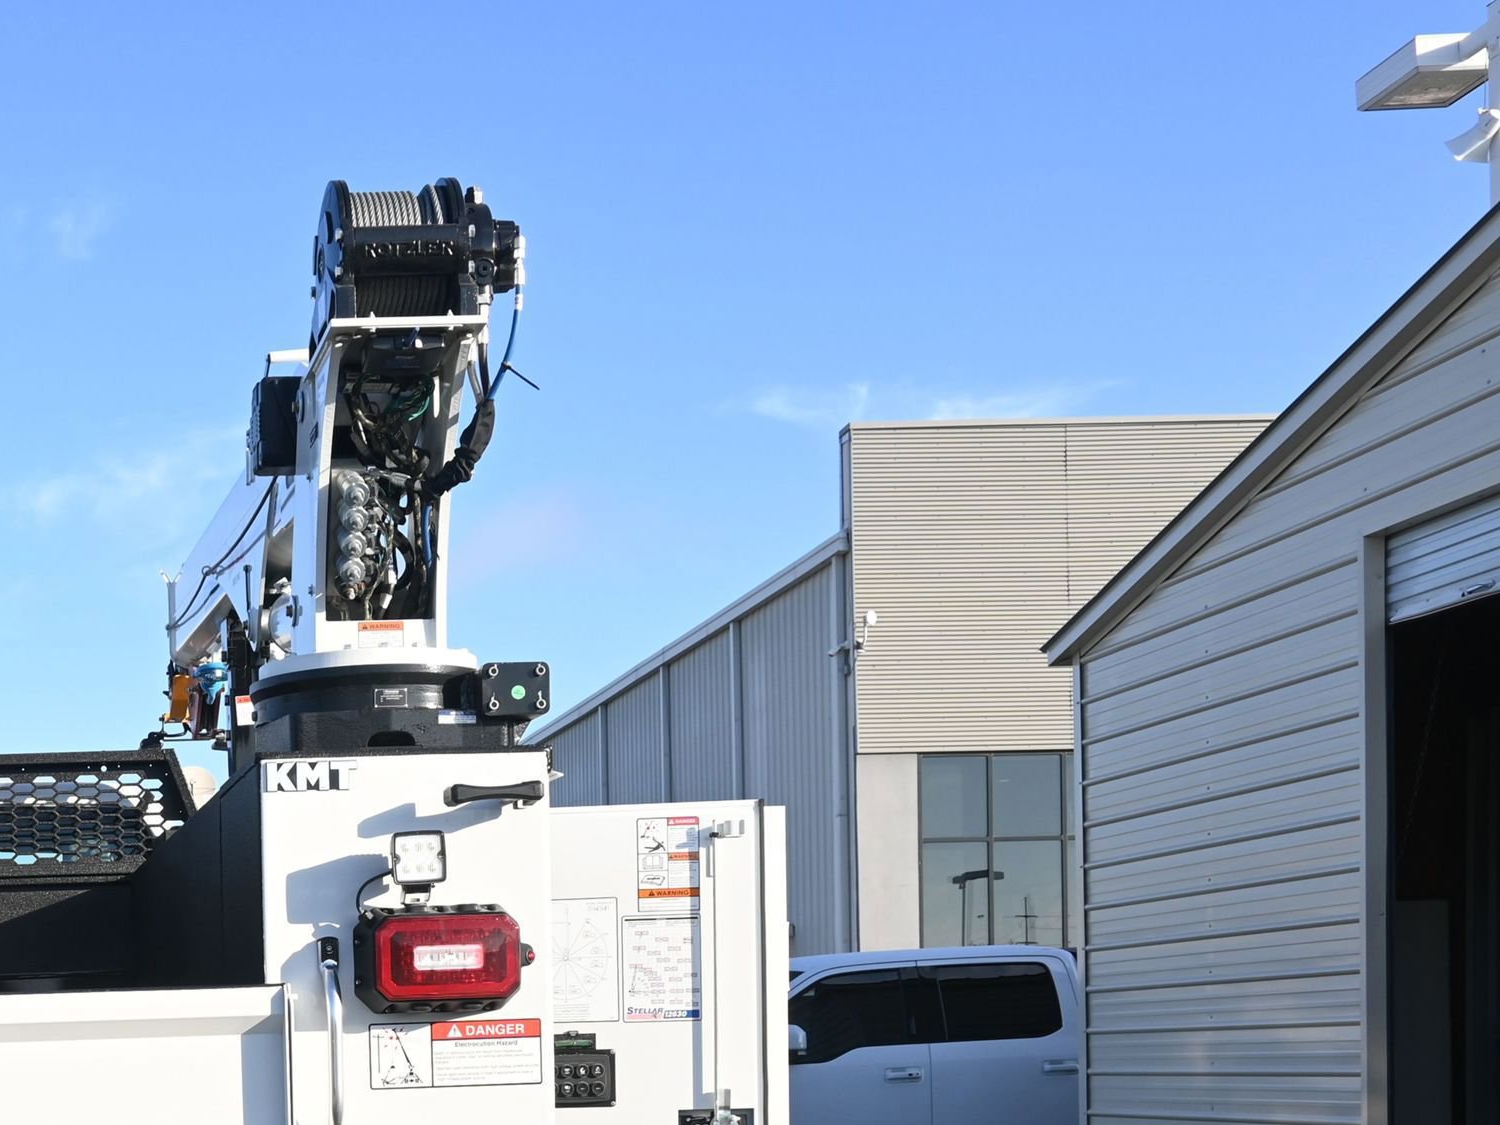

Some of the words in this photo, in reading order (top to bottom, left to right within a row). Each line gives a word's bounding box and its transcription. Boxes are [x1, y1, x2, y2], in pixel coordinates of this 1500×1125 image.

[364, 240, 455, 258] ROTZLER
[264, 760, 357, 792] KMT
[465, 1023, 525, 1036] DANGER
[454, 1040, 496, 1048] Electrocution
